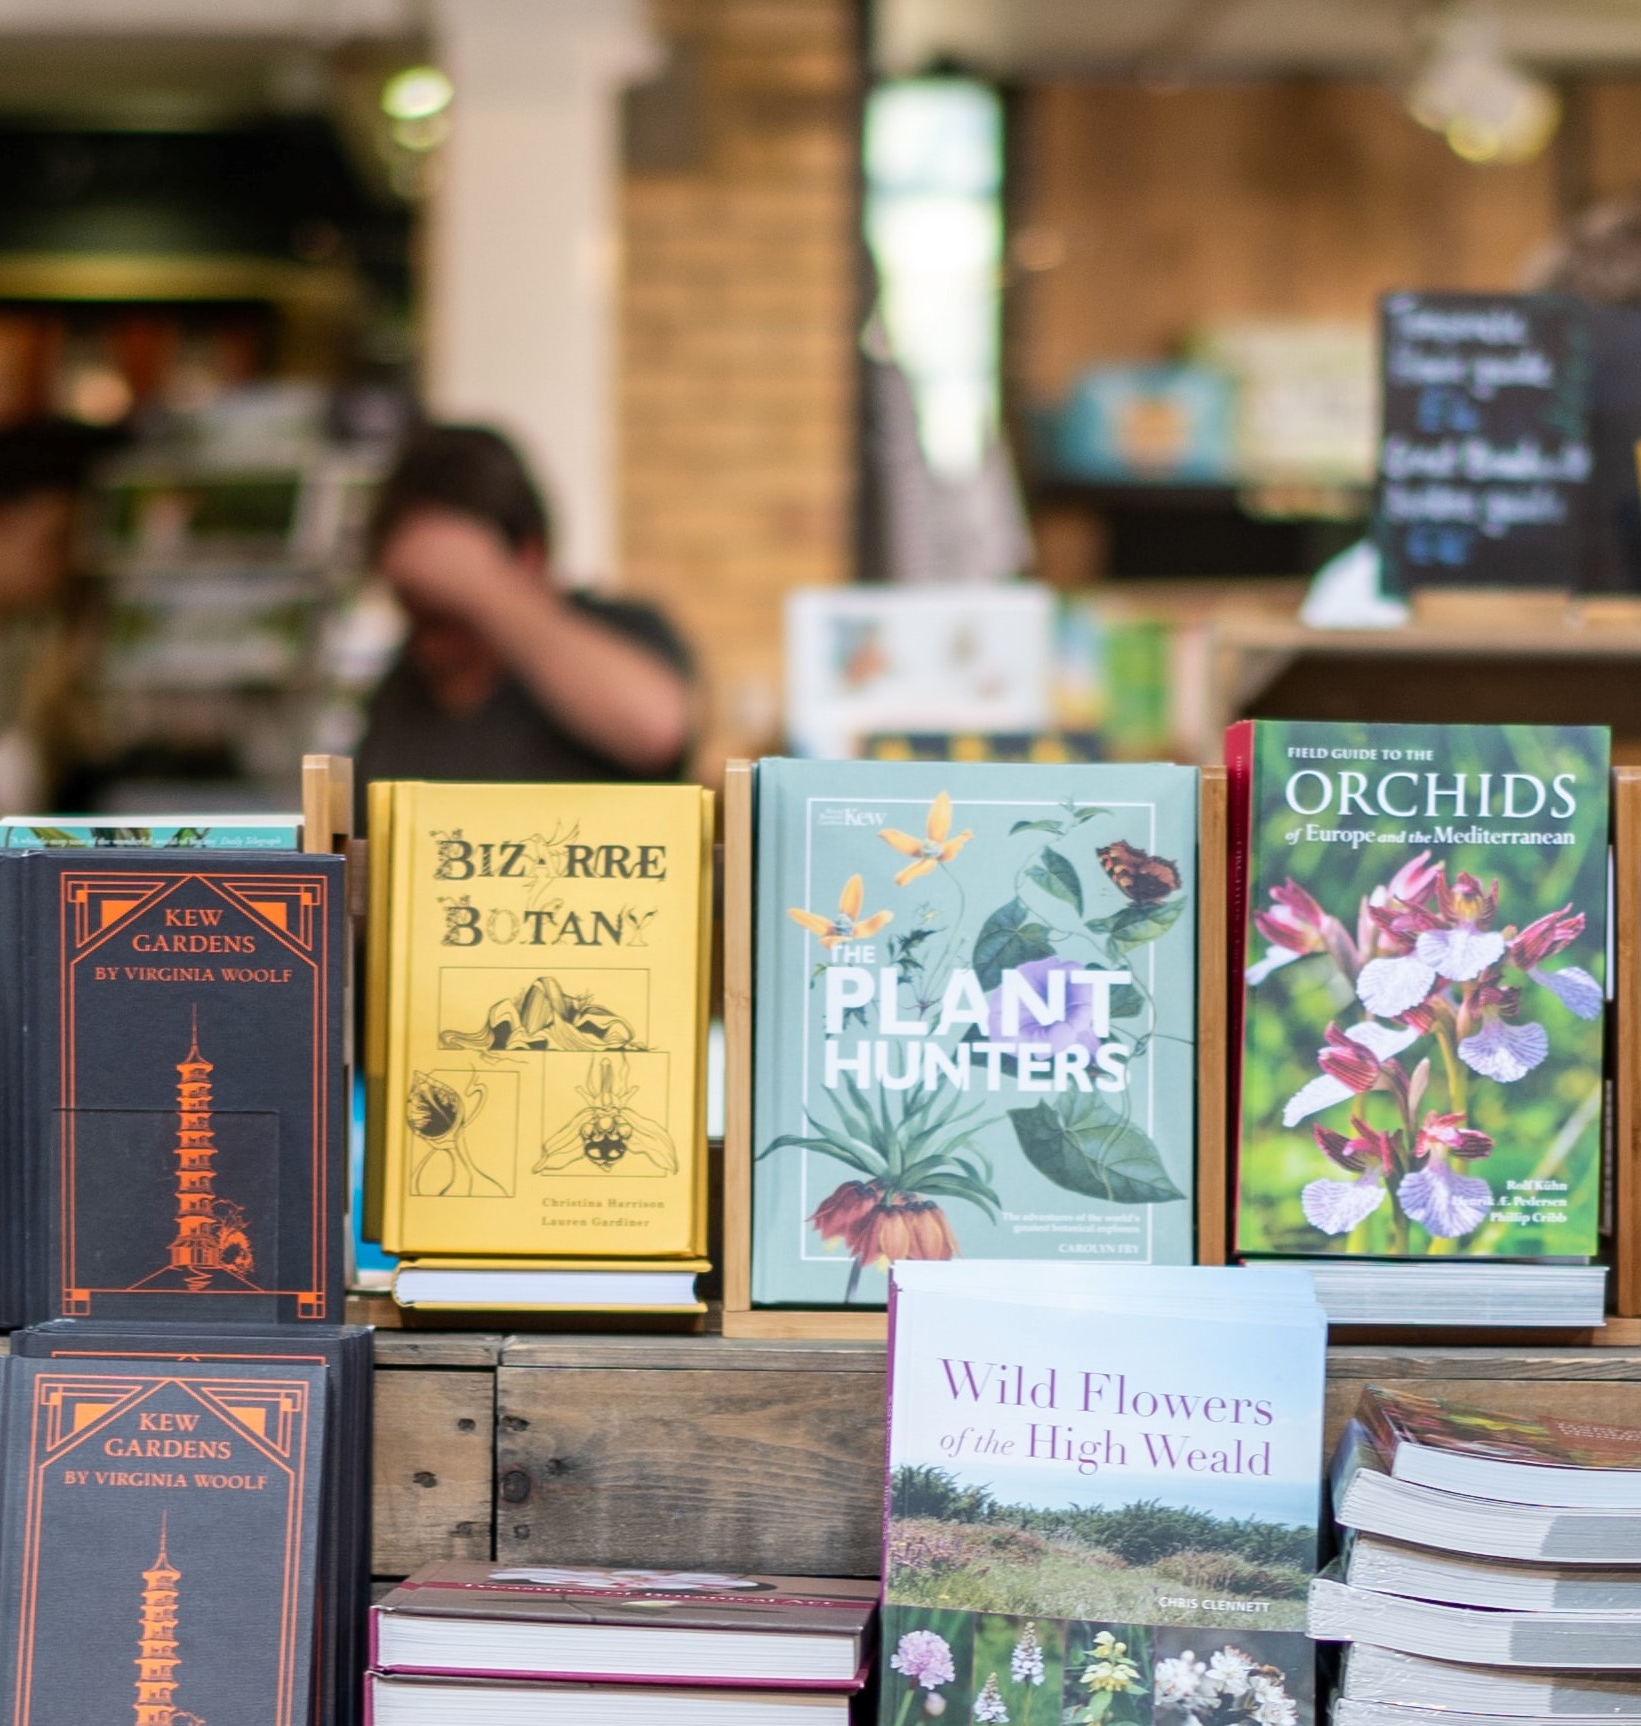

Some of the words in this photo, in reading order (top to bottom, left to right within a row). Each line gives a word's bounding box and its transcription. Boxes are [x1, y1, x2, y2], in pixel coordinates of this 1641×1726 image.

[1287, 747, 1329, 759] FIELD
[1331, 748, 1378, 760] GUIDE
[1382, 749, 1401, 760] TO
[1406, 750, 1433, 761] THE
[1285, 769, 1576, 819] ORCHIDS
[844, 808, 887, 826] Kew
[1285, 827, 1302, 845] of
[1306, 824, 1376, 849] Europe
[1377, 831, 1406, 843] and
[1408, 831, 1432, 844] the
[1433, 826, 1576, 845] Mediterranean
[430, 826, 667, 882] BIZARRE
[165, 909, 223, 927] KEW
[437, 895, 658, 947] BOTANY
[132, 934, 256, 954] GARDENS
[831, 945, 876, 964] THE
[94, 967, 120, 981] BY
[124, 967, 215, 983] VIRGINIA
[221, 968, 293, 983] WOOLF
[825, 966, 1132, 1038] PLANT
[824, 1039, 1131, 1093] HUNTERS
[1506, 1179, 1536, 1191] Rolf
[1538, 1179, 1568, 1191] Kühn
[541, 1198, 603, 1208] Christina
[608, 1198, 665, 1209] Harrison
[1513, 1196, 1568, 1207] Pedersen
[541, 1216, 587, 1226] Lauren
[592, 1216, 650, 1227] Gardiner
[1532, 1212, 1568, 1223] Cribb
[1058, 1243, 1114, 1254] CAROLYN
[1117, 1244, 1139, 1254] FRY
[936, 1357, 1059, 1410] Wild
[1077, 1371, 1274, 1427] Flowers
[139, 1413, 200, 1432] KEW
[104, 1438, 231, 1459] GARDENS
[940, 1426, 975, 1458] of
[974, 1428, 1016, 1456] the
[1024, 1423, 1129, 1476] High
[1139, 1432, 1274, 1477] Weald
[64, 1470, 89, 1485] BY
[94, 1471, 188, 1488] VIRGINIA
[194, 1474, 268, 1490] WOOLF
[1158, 1596, 1198, 1609] CHRIS
[1201, 1599, 1271, 1613] CLENNETT
